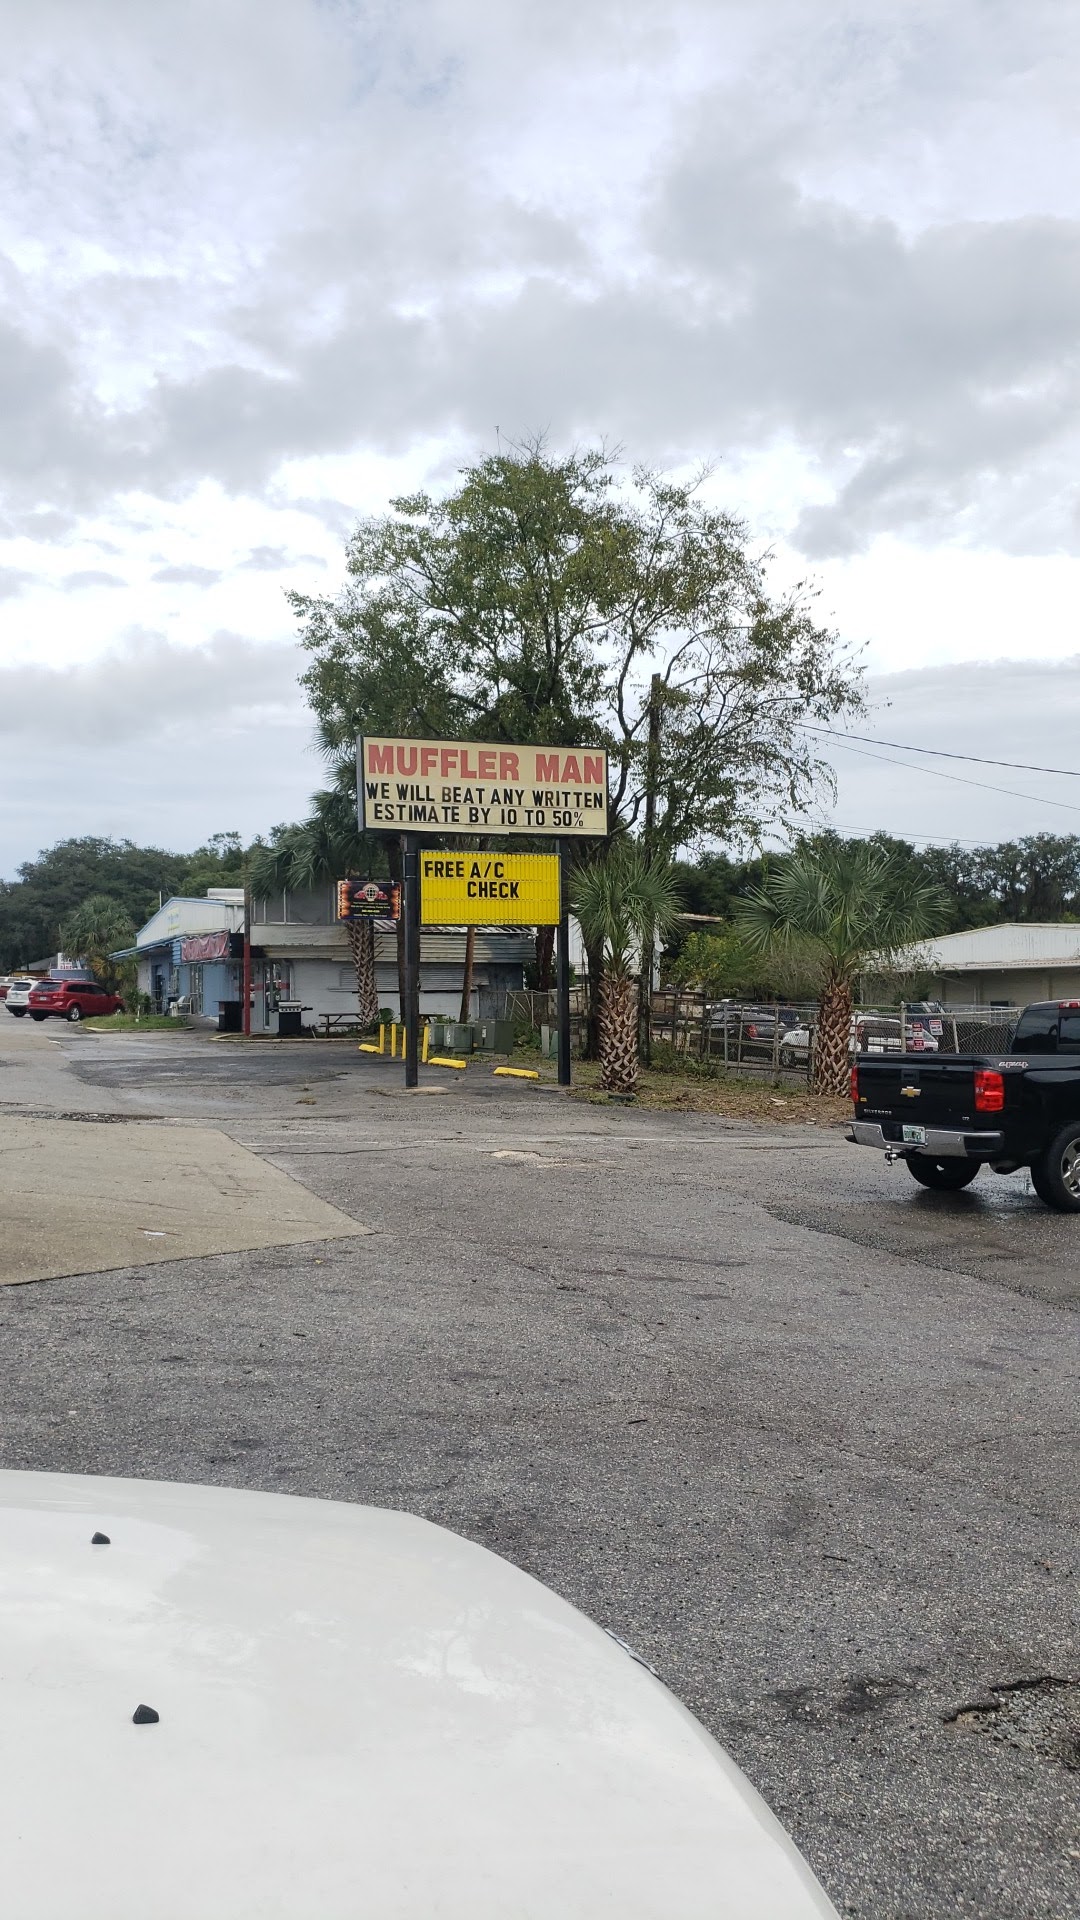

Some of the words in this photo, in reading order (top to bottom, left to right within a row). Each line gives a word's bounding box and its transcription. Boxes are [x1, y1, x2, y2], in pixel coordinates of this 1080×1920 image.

[368, 744, 520, 781] MUFFLER
[535, 753, 603, 785] MAN
[366, 782, 390, 799] WE
[396, 783, 436, 802] WILL
[442, 786, 485, 804] BEAT
[490, 788, 525, 806] ANY
[532, 790, 603, 809] WRITTEN
[374, 803, 460, 823] ESTIMATE
[469, 806, 491, 824] BY
[501, 808, 517, 825] 10
[525, 809, 546, 826] TO
[552, 810, 584, 827] 50%
[424, 860, 465, 878] FREE
[470, 861, 504, 879] A/C
[467, 881, 520, 898] CHECK
